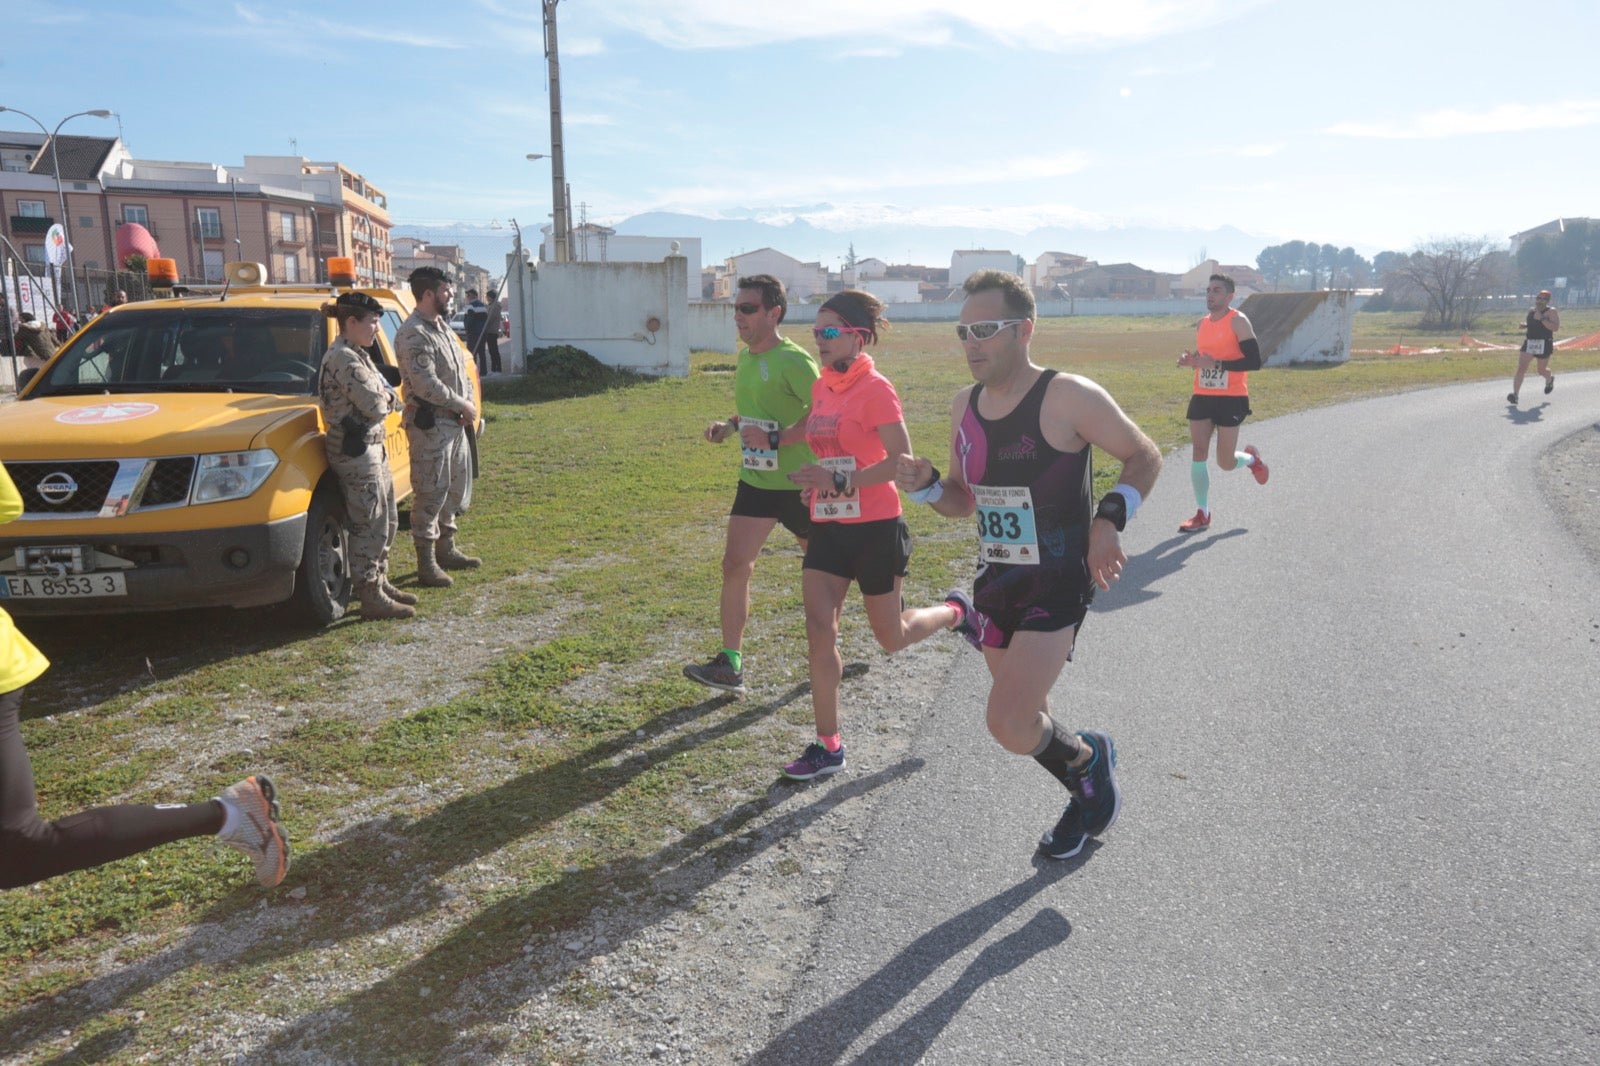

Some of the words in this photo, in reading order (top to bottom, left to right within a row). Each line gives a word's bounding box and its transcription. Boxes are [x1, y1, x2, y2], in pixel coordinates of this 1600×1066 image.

[8, 579, 35, 596] EA
[41, 577, 93, 596] 8553
[103, 576, 115, 593] 3
